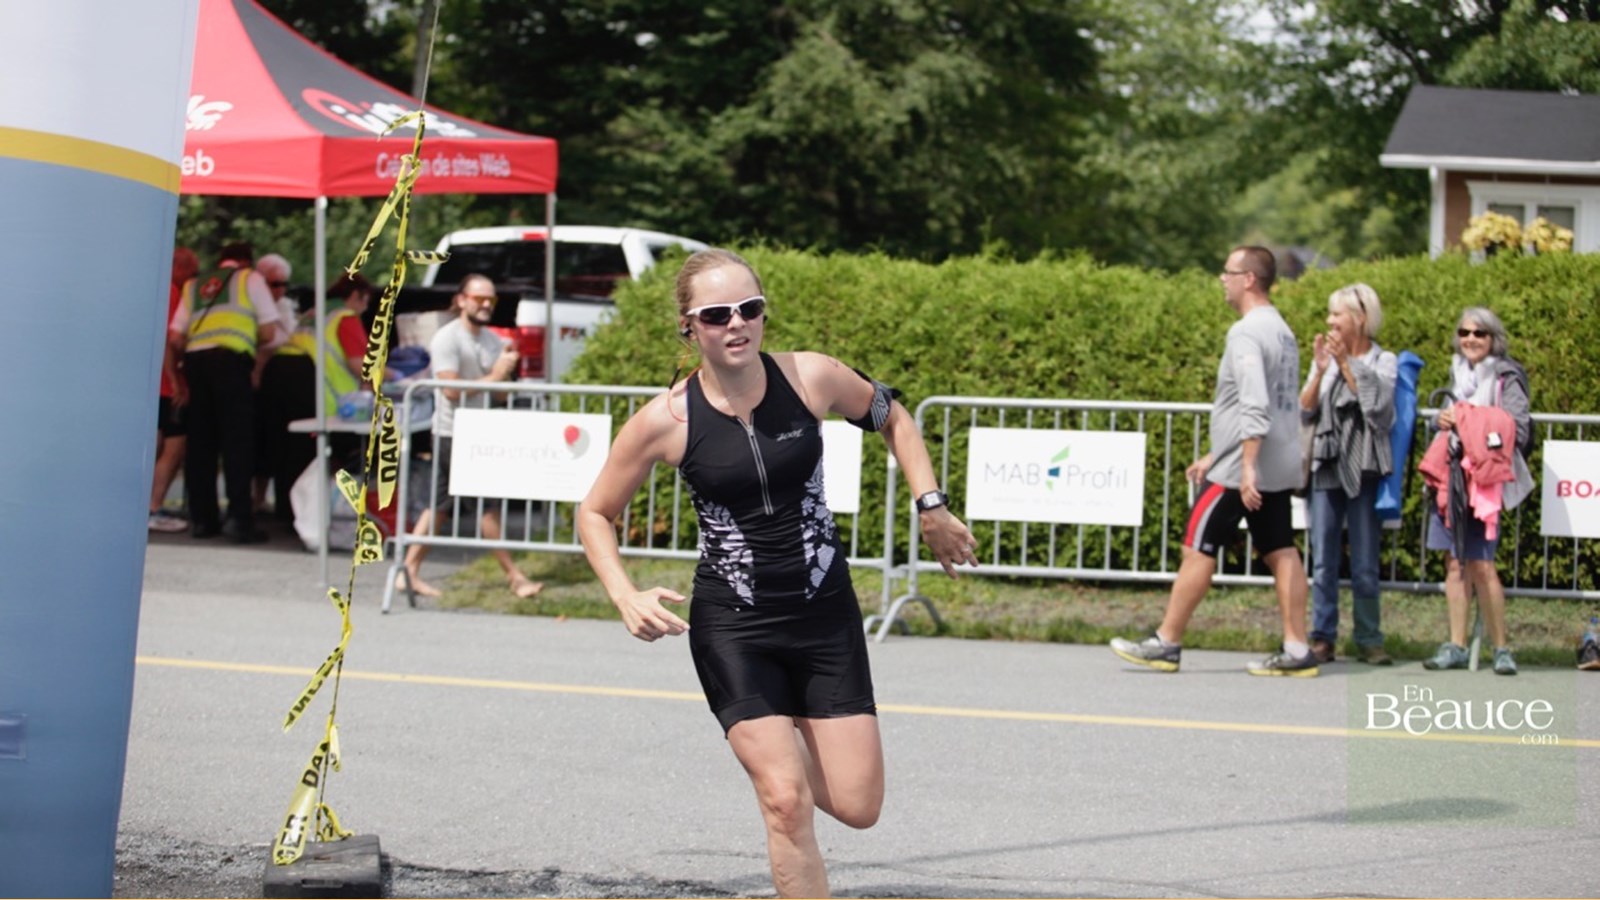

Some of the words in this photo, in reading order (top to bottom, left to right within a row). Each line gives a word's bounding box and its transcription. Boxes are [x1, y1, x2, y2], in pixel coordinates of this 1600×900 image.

[181, 148, 216, 176] eb
[984, 462, 1041, 486] MAB
[1067, 464, 1128, 489] Profil
